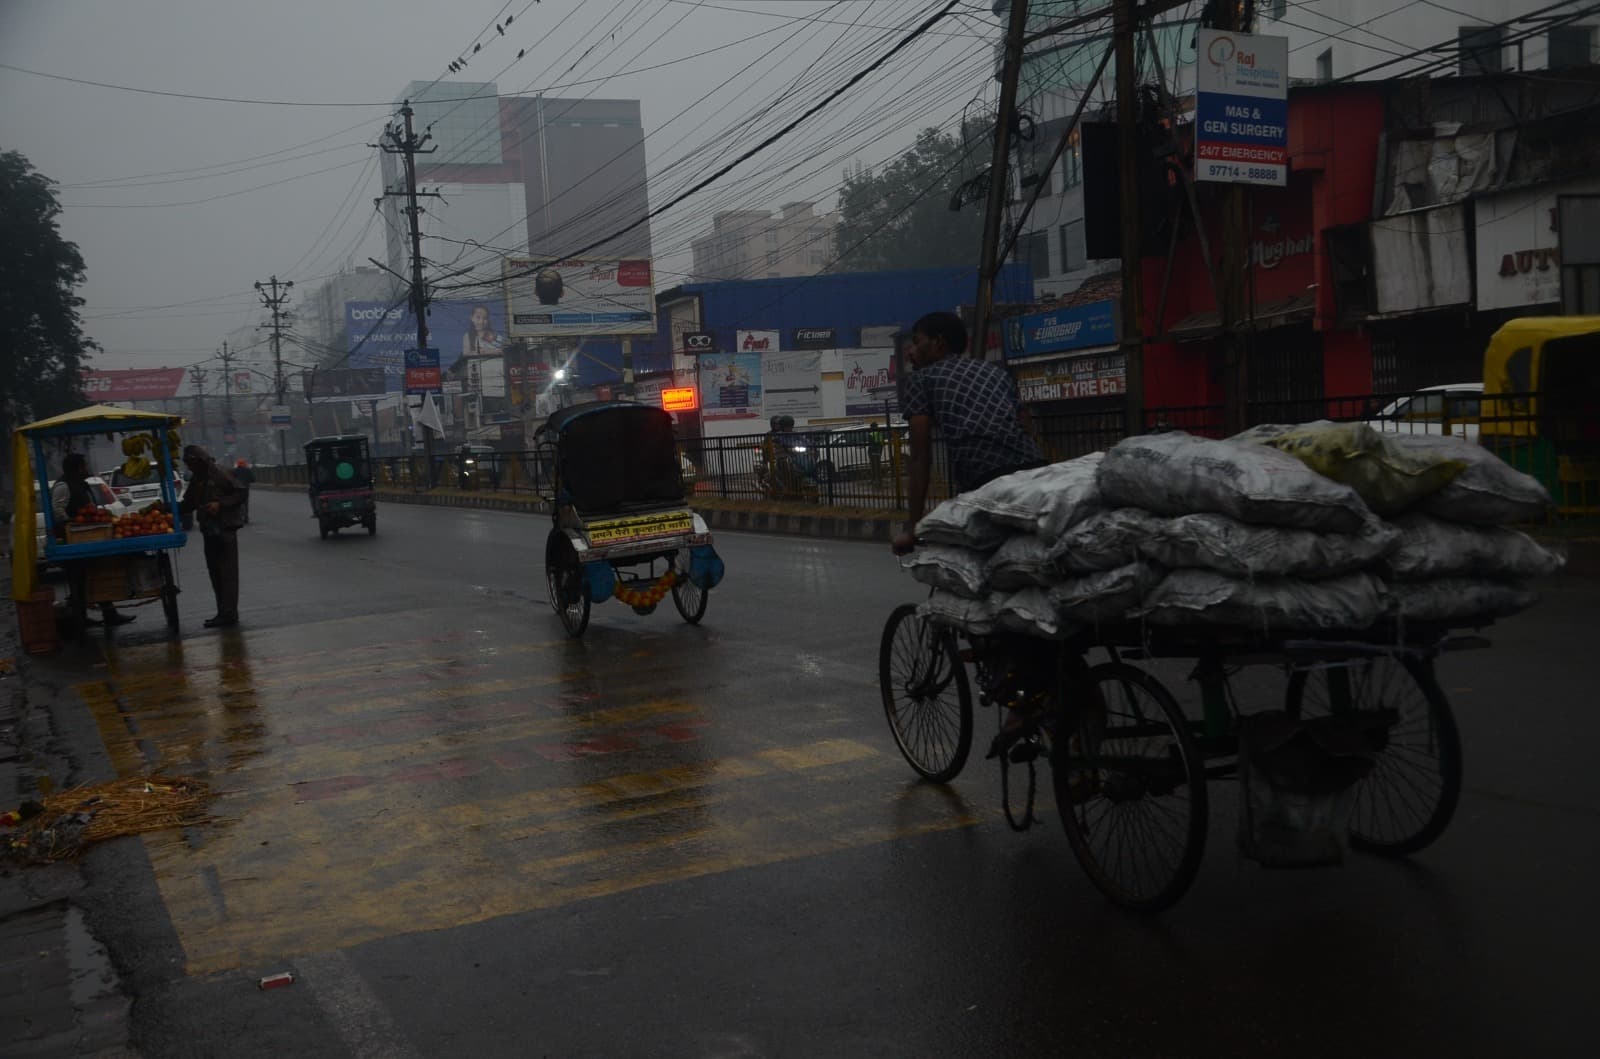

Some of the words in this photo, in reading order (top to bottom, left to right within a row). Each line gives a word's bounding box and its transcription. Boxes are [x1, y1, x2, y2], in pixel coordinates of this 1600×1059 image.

[1237, 51, 1255, 68] Raj
[1225, 105, 1250, 118] MAS
[1252, 107, 1261, 119] &
[1204, 120, 1228, 134] GEN
[1231, 123, 1284, 139] SURGERY
[1200, 145, 1220, 156] 24/7
[1222, 147, 1283, 161] EMERGENCY
[1209, 165, 1239, 177] 97714
[352, 307, 403, 320] brother
[1043, 317, 1056, 327] TVS
[1020, 383, 1061, 401] RANCHI
[1062, 379, 1098, 397] TYRE
